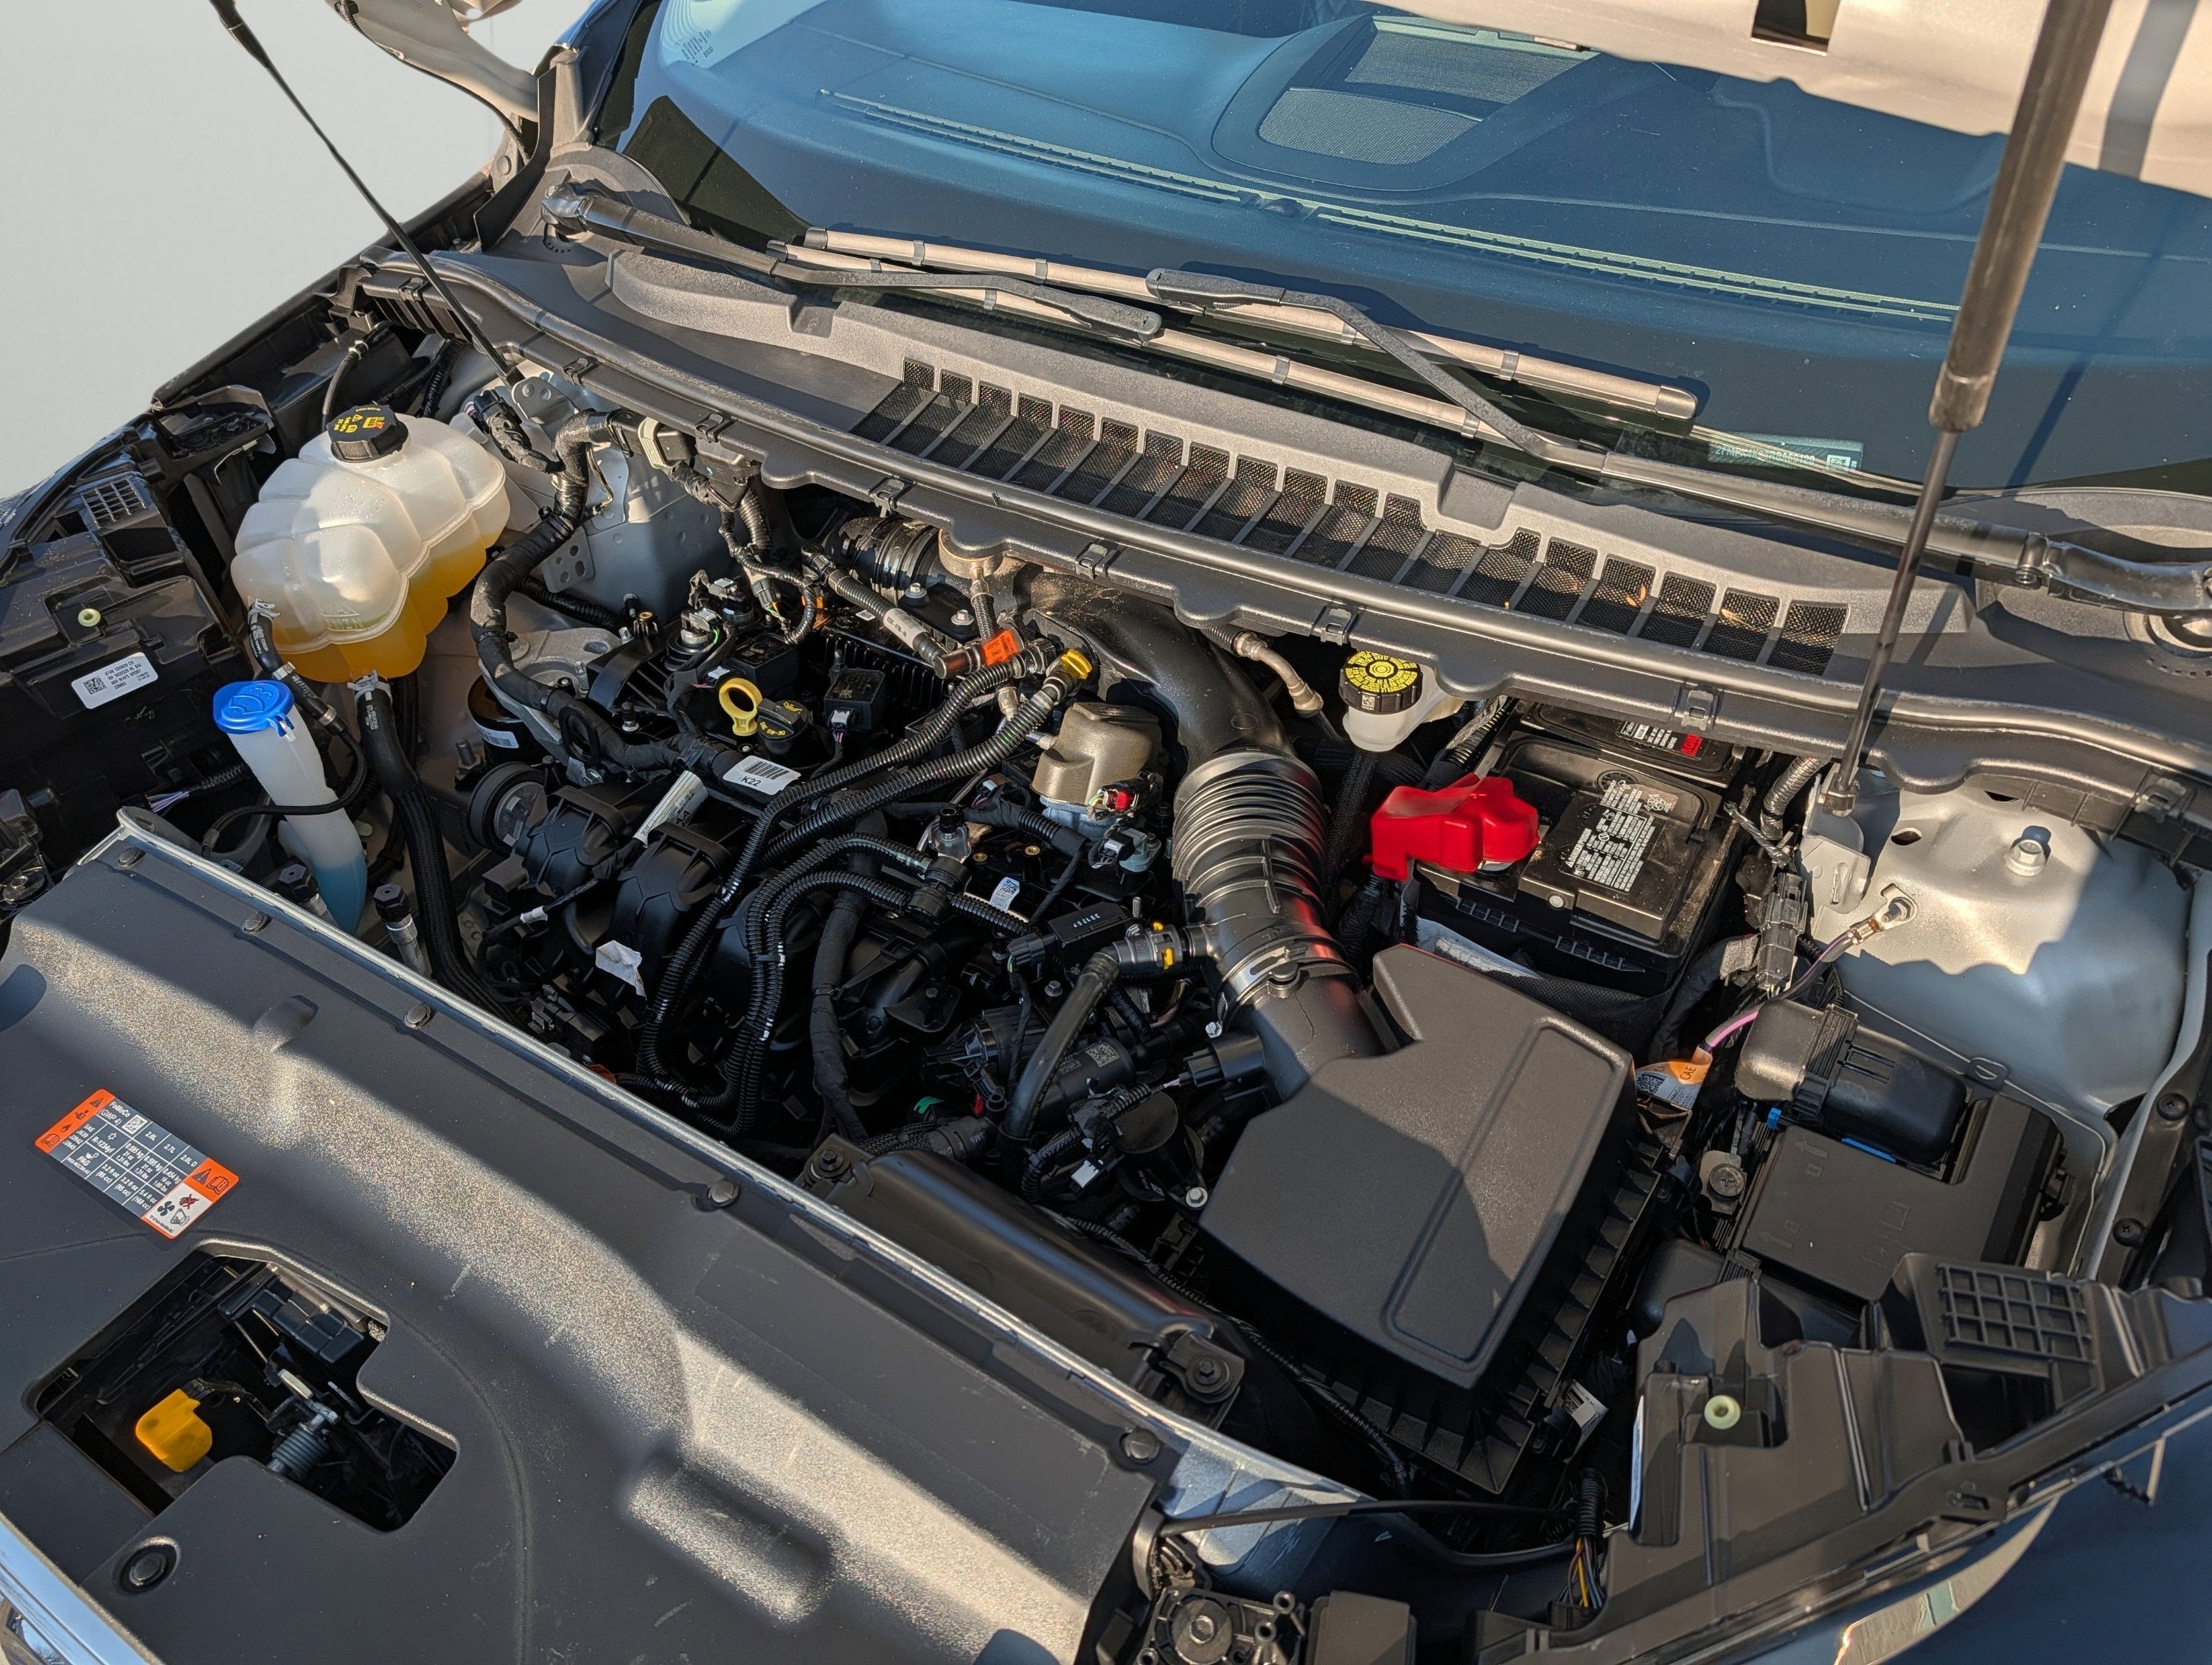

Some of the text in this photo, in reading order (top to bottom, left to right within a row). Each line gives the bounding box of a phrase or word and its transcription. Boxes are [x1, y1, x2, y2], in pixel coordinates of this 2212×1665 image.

[759, 721, 768, 731] SAE
[740, 776, 762, 788] K22
[1680, 1066, 1697, 1080] CAE
[97, 1107, 118, 1122] (GWP
[108, 1101, 132, 1118] FoMoCo
[83, 1123, 96, 1133] SAE
[144, 1130, 159, 1141] 2.0L
[88, 1136, 115, 1155] R-1234yf
[163, 1143, 178, 1153] 2.7L
[133, 1150, 145, 1159] kg
[179, 1153, 194, 1164] 2.0L
[76, 1155, 91, 1167] PAG
[101, 1163, 112, 1172] 3.2
[153, 1162, 164, 1172] kg
[101, 1175, 114, 1184] cc)
[119, 1175, 131, 1184] 3.2
[161, 1167, 184, 1184] 0.454 kg
[120, 1188, 133, 1198] cc)
[138, 1188, 149, 1197] 5.4
[139, 1201, 152, 1211] cc)
